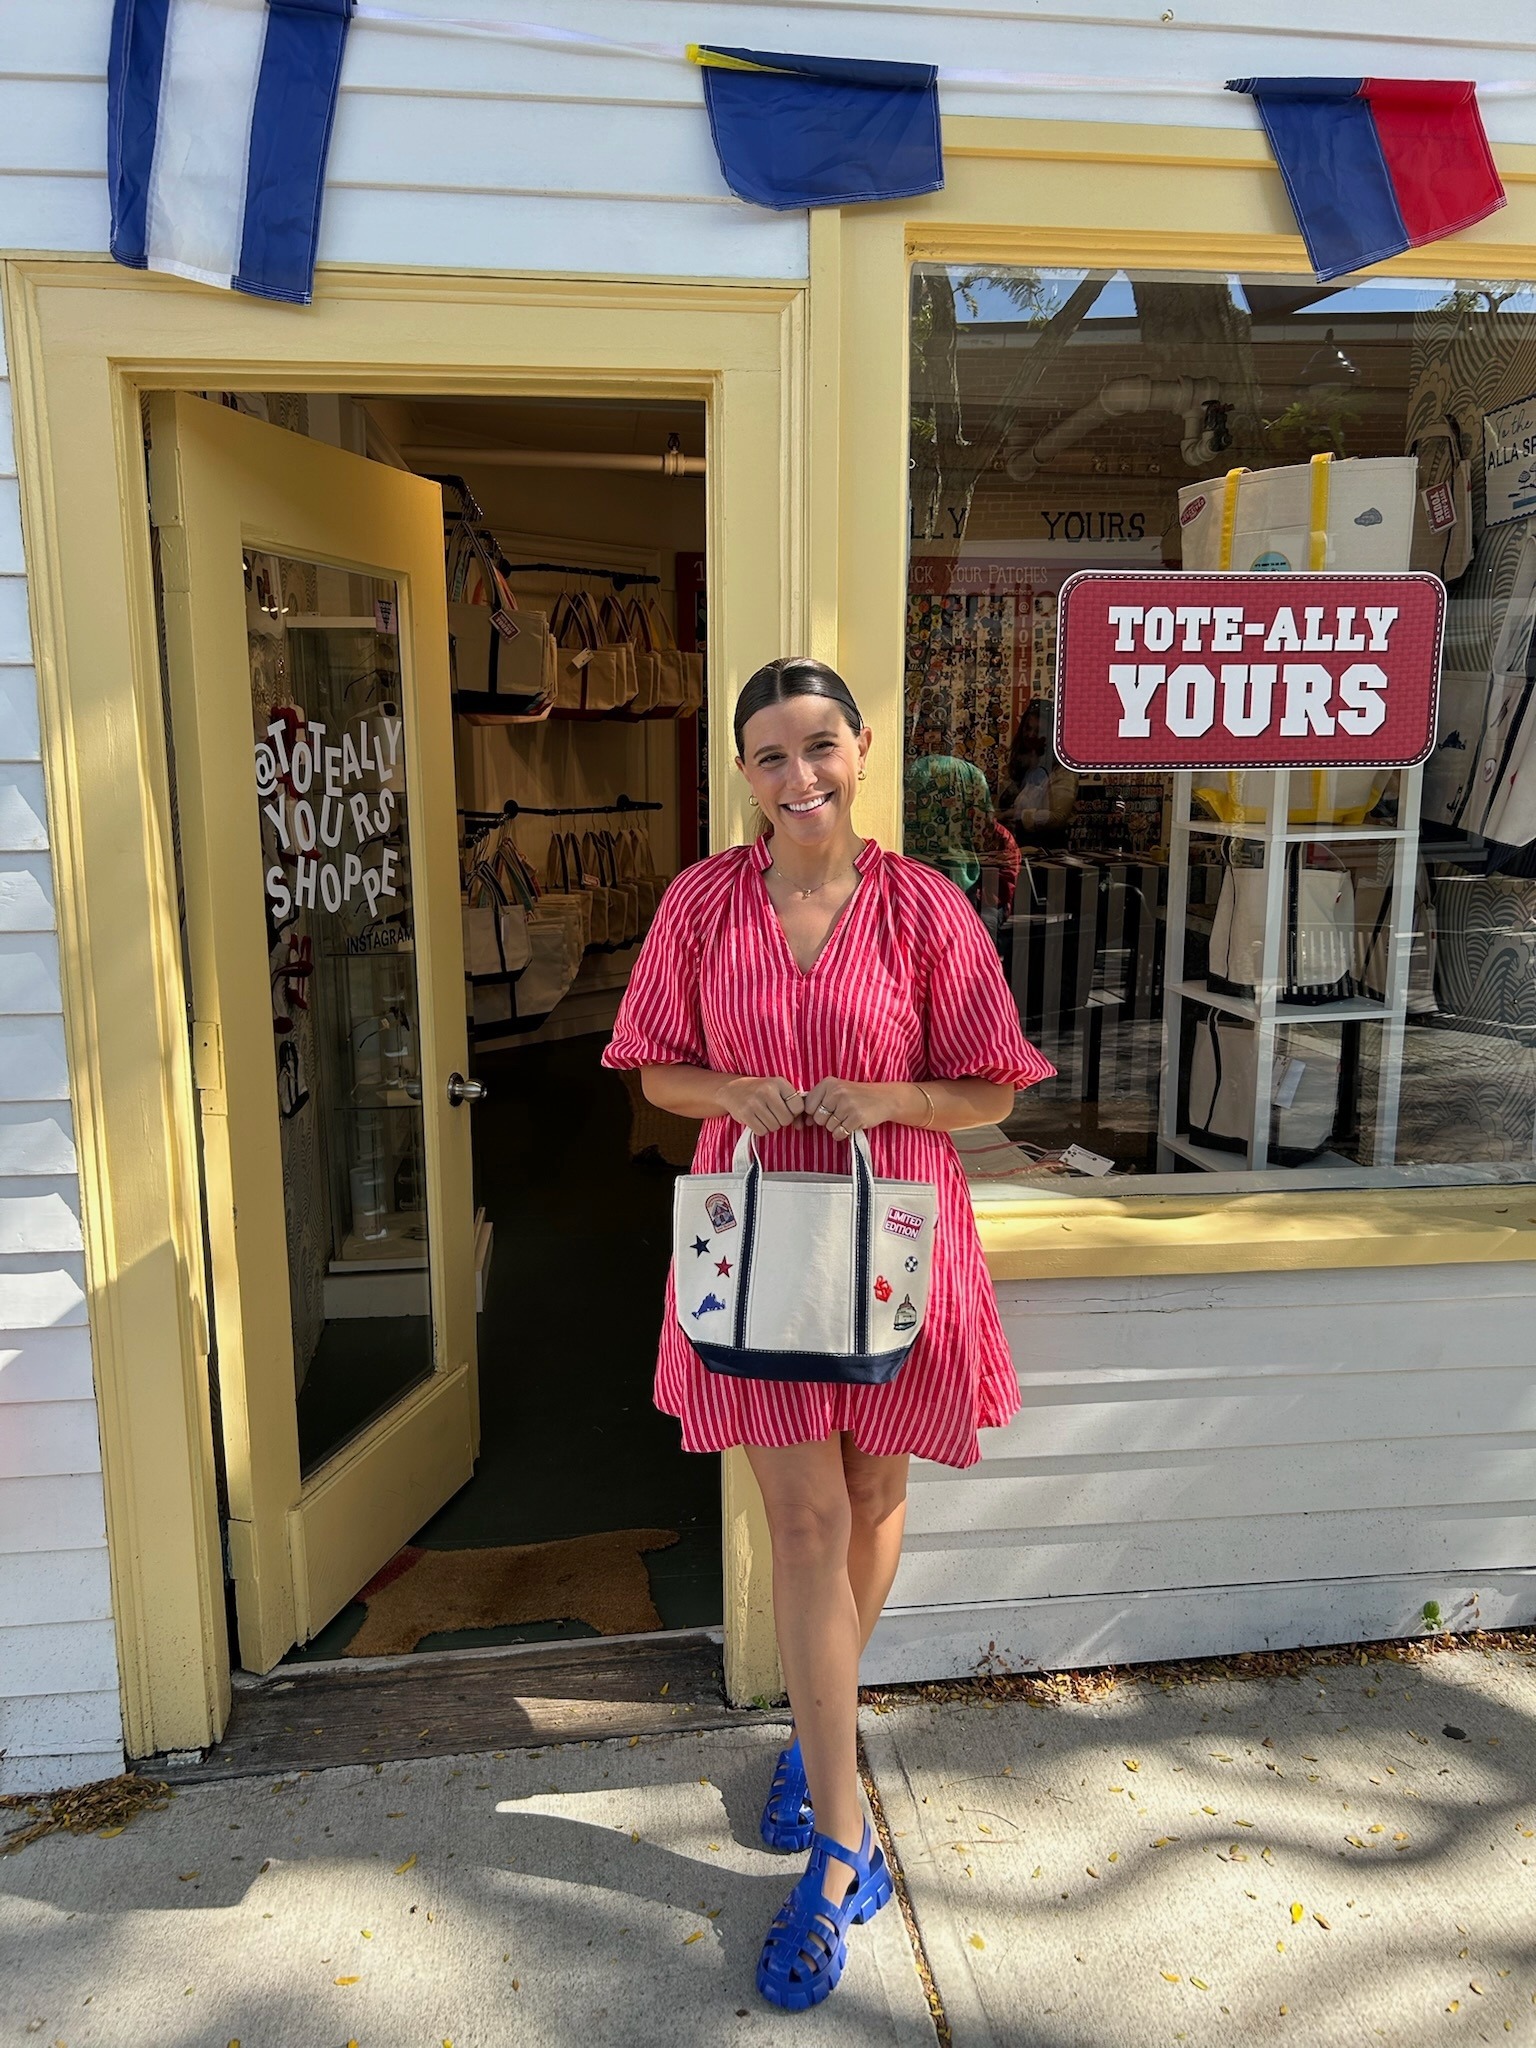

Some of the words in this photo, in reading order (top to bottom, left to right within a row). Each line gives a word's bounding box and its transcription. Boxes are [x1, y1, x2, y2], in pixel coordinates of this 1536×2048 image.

[1511, 409, 1533, 434] the
[1488, 442, 1519, 470] ALLA
[1430, 491, 1445, 523] YOURS
[1041, 511, 1146, 542] YOURS
[945, 564, 983, 584] YOUR
[988, 564, 1048, 584] PATCHES
[1002, 587, 1032, 595] Patches
[1108, 606, 1398, 651] TOTE-ALLY
[1016, 601, 1030, 722] @TOTEALL
[1108, 663, 1388, 738] YOURS
[254, 717, 402, 797] @TOTEALLY
[263, 787, 395, 851] YOURS
[266, 848, 398, 919] SHOPPE
[346, 925, 414, 955] INSTAGRAM
[885, 1220, 919, 1238] EDITION
[889, 1209, 922, 1227] LIMITED
